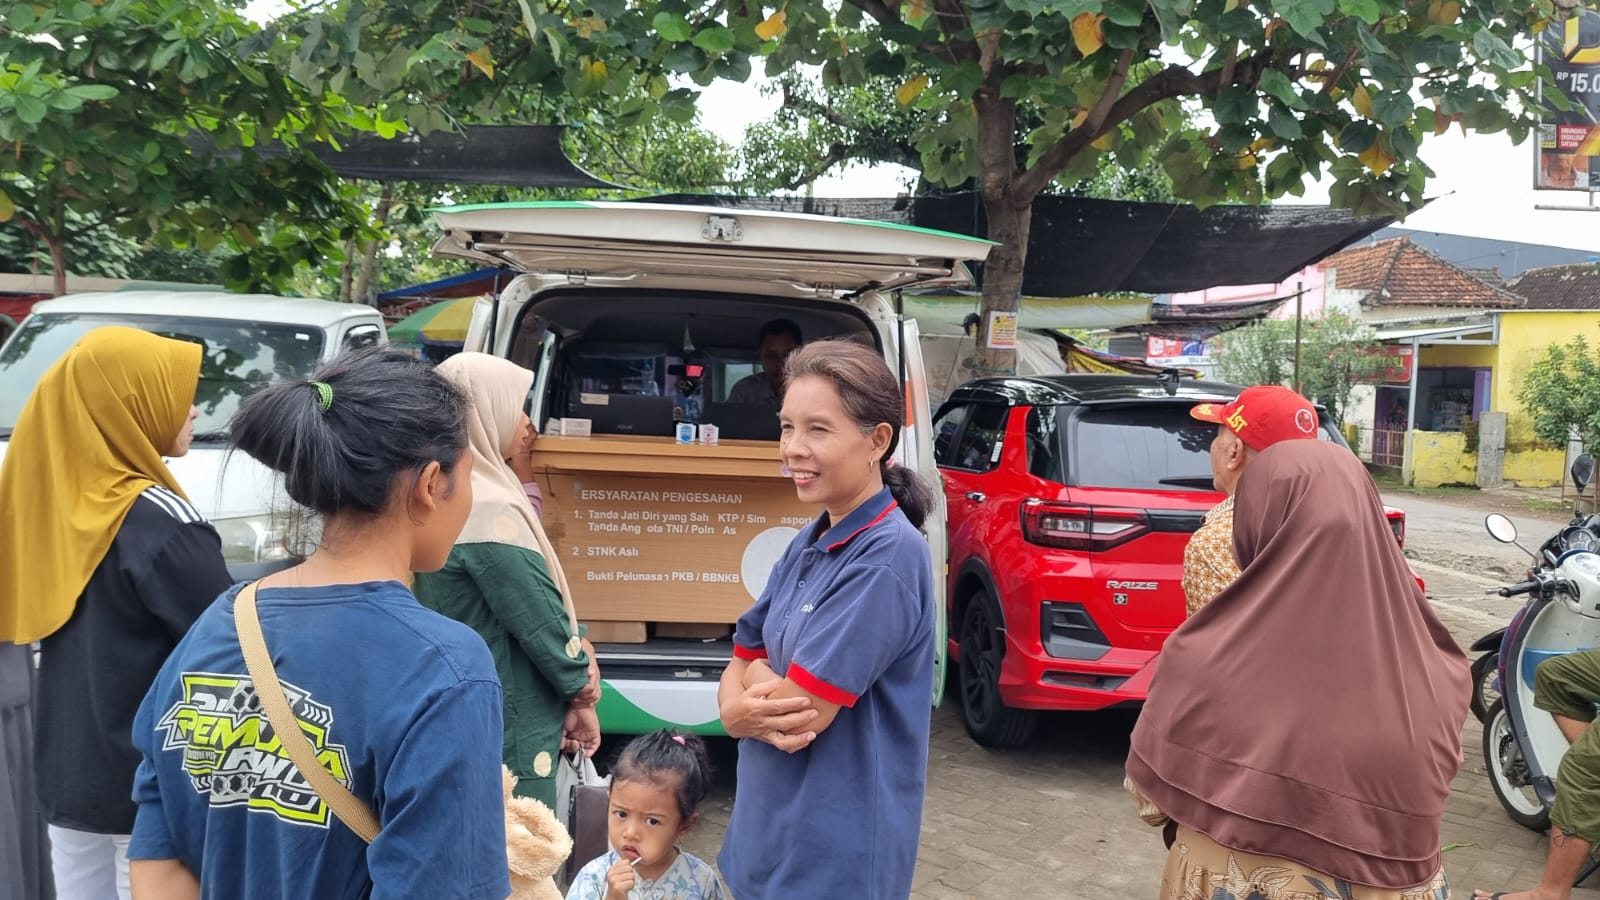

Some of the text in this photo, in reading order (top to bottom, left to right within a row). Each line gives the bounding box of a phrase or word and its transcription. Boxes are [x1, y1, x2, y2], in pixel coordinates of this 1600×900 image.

[1556, 72, 1568, 80] RP
[1226, 404, 1248, 432] 1ST
[662, 492, 743, 504] PENGESAHAN
[573, 510, 583, 519] 1.
[587, 510, 619, 519] Tanda
[621, 511, 640, 520] Jati
[642, 511, 660, 520] Diri
[662, 513, 687, 523] yang
[689, 513, 709, 522] Sah
[718, 513, 739, 522] KTP
[747, 514, 766, 523] Sim
[587, 522, 619, 531] Tanda
[666, 524, 683, 533] TNI
[586, 547, 616, 556] STNK
[586, 571, 613, 581] Bukti
[671, 572, 694, 581] PKB
[702, 573, 739, 583] BBNKB
[1106, 580, 1159, 590] RAIZE
[175, 707, 348, 781] PEMUA
